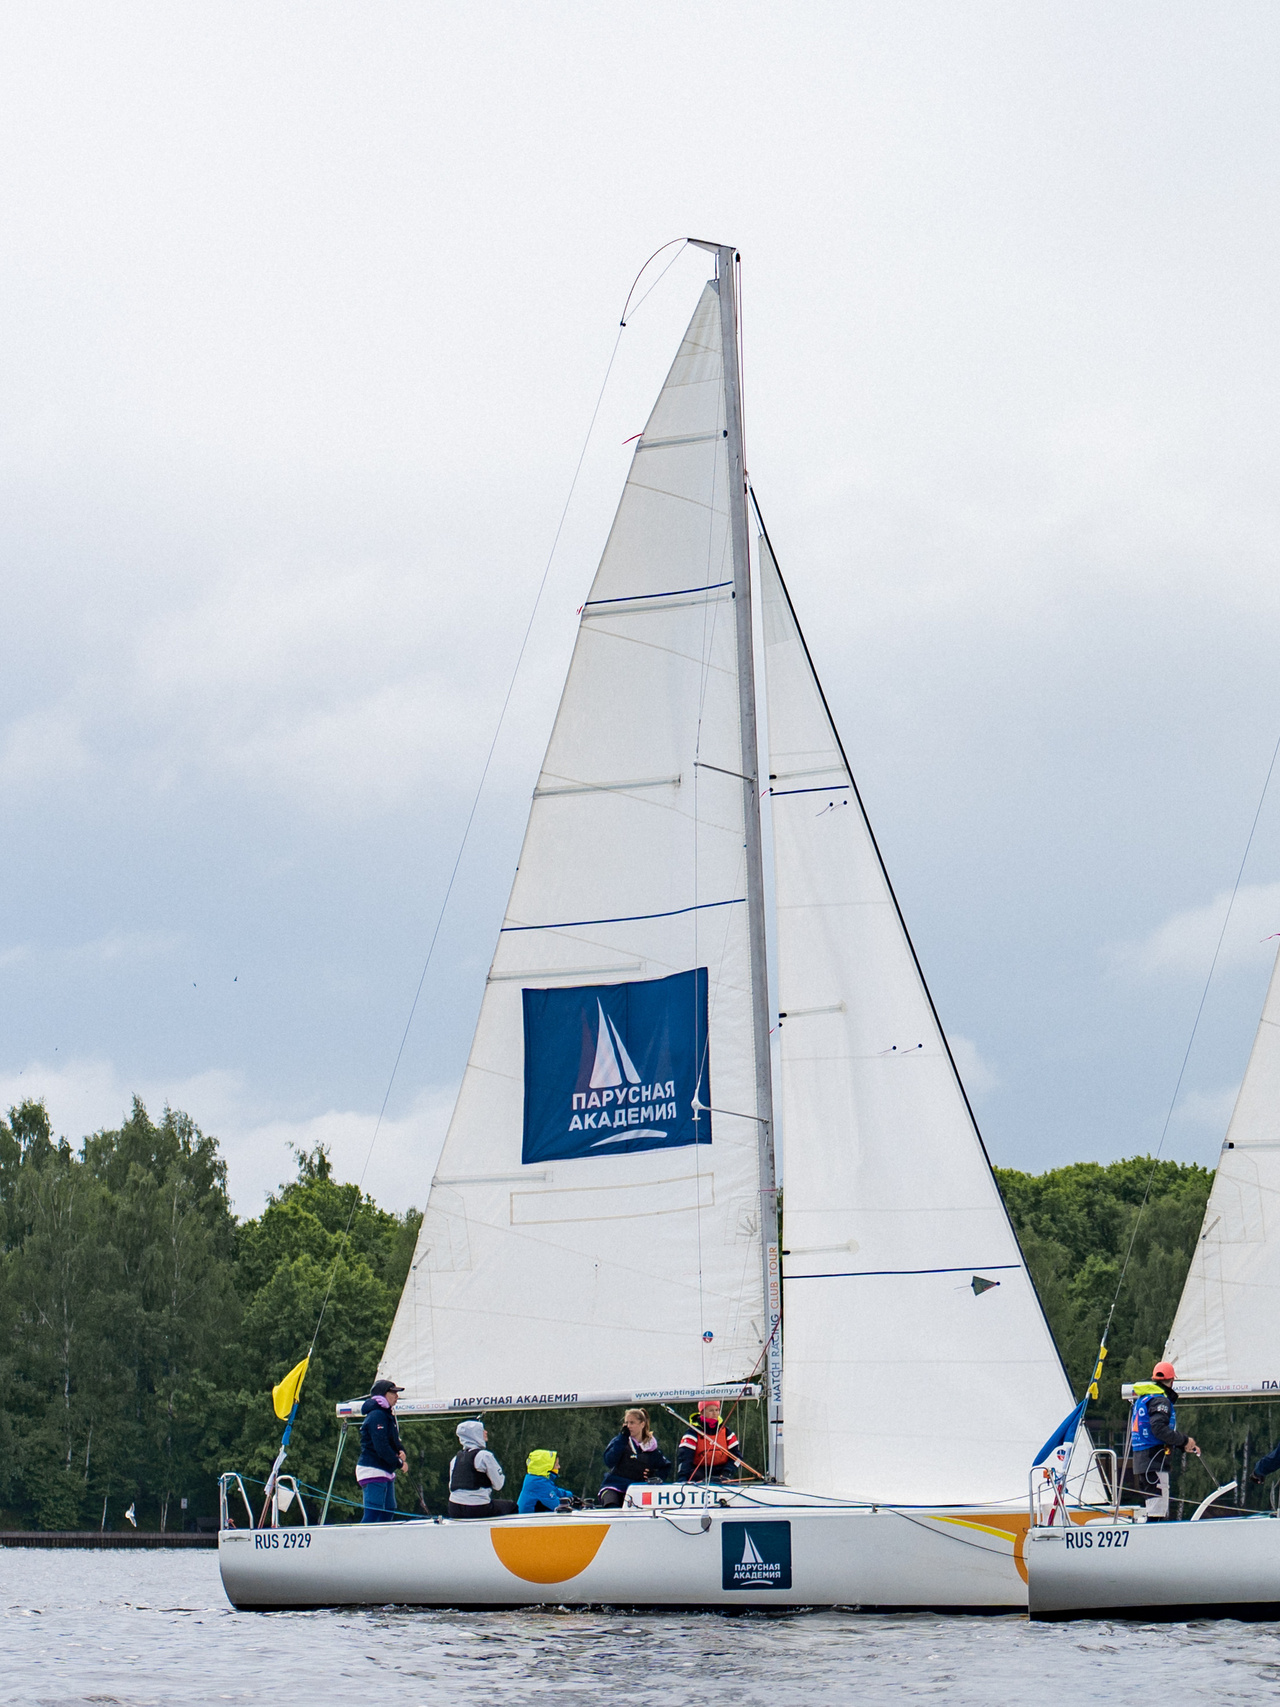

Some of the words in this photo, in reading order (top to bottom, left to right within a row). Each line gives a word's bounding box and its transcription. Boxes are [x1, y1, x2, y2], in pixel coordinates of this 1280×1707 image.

[572, 1080, 675, 1111] ПАРУСНАЯ
[568, 1101, 677, 1132] АКАДЕМИЯ
[769, 1246, 778, 1277] TOUR
[770, 1281, 779, 1310] CLUB
[770, 1314, 780, 1357] RACING
[771, 1362, 781, 1402] MATCH
[453, 1395, 512, 1407] ПАРУСНАЯ
[516, 1393, 579, 1405] АКАДЕМИЯ
[635, 1387, 743, 1399] www.yachtingacademy.ru
[658, 1491, 721, 1505] HOTEL
[255, 1533, 279, 1550] RUS
[282, 1532, 312, 1549] 2929
[1066, 1531, 1093, 1549] RUS
[1097, 1530, 1130, 1548] 2927
[733, 1571, 781, 1580] АКАДЕМИЯ
[734, 1563, 781, 1572] ПАРУСНАЯ
